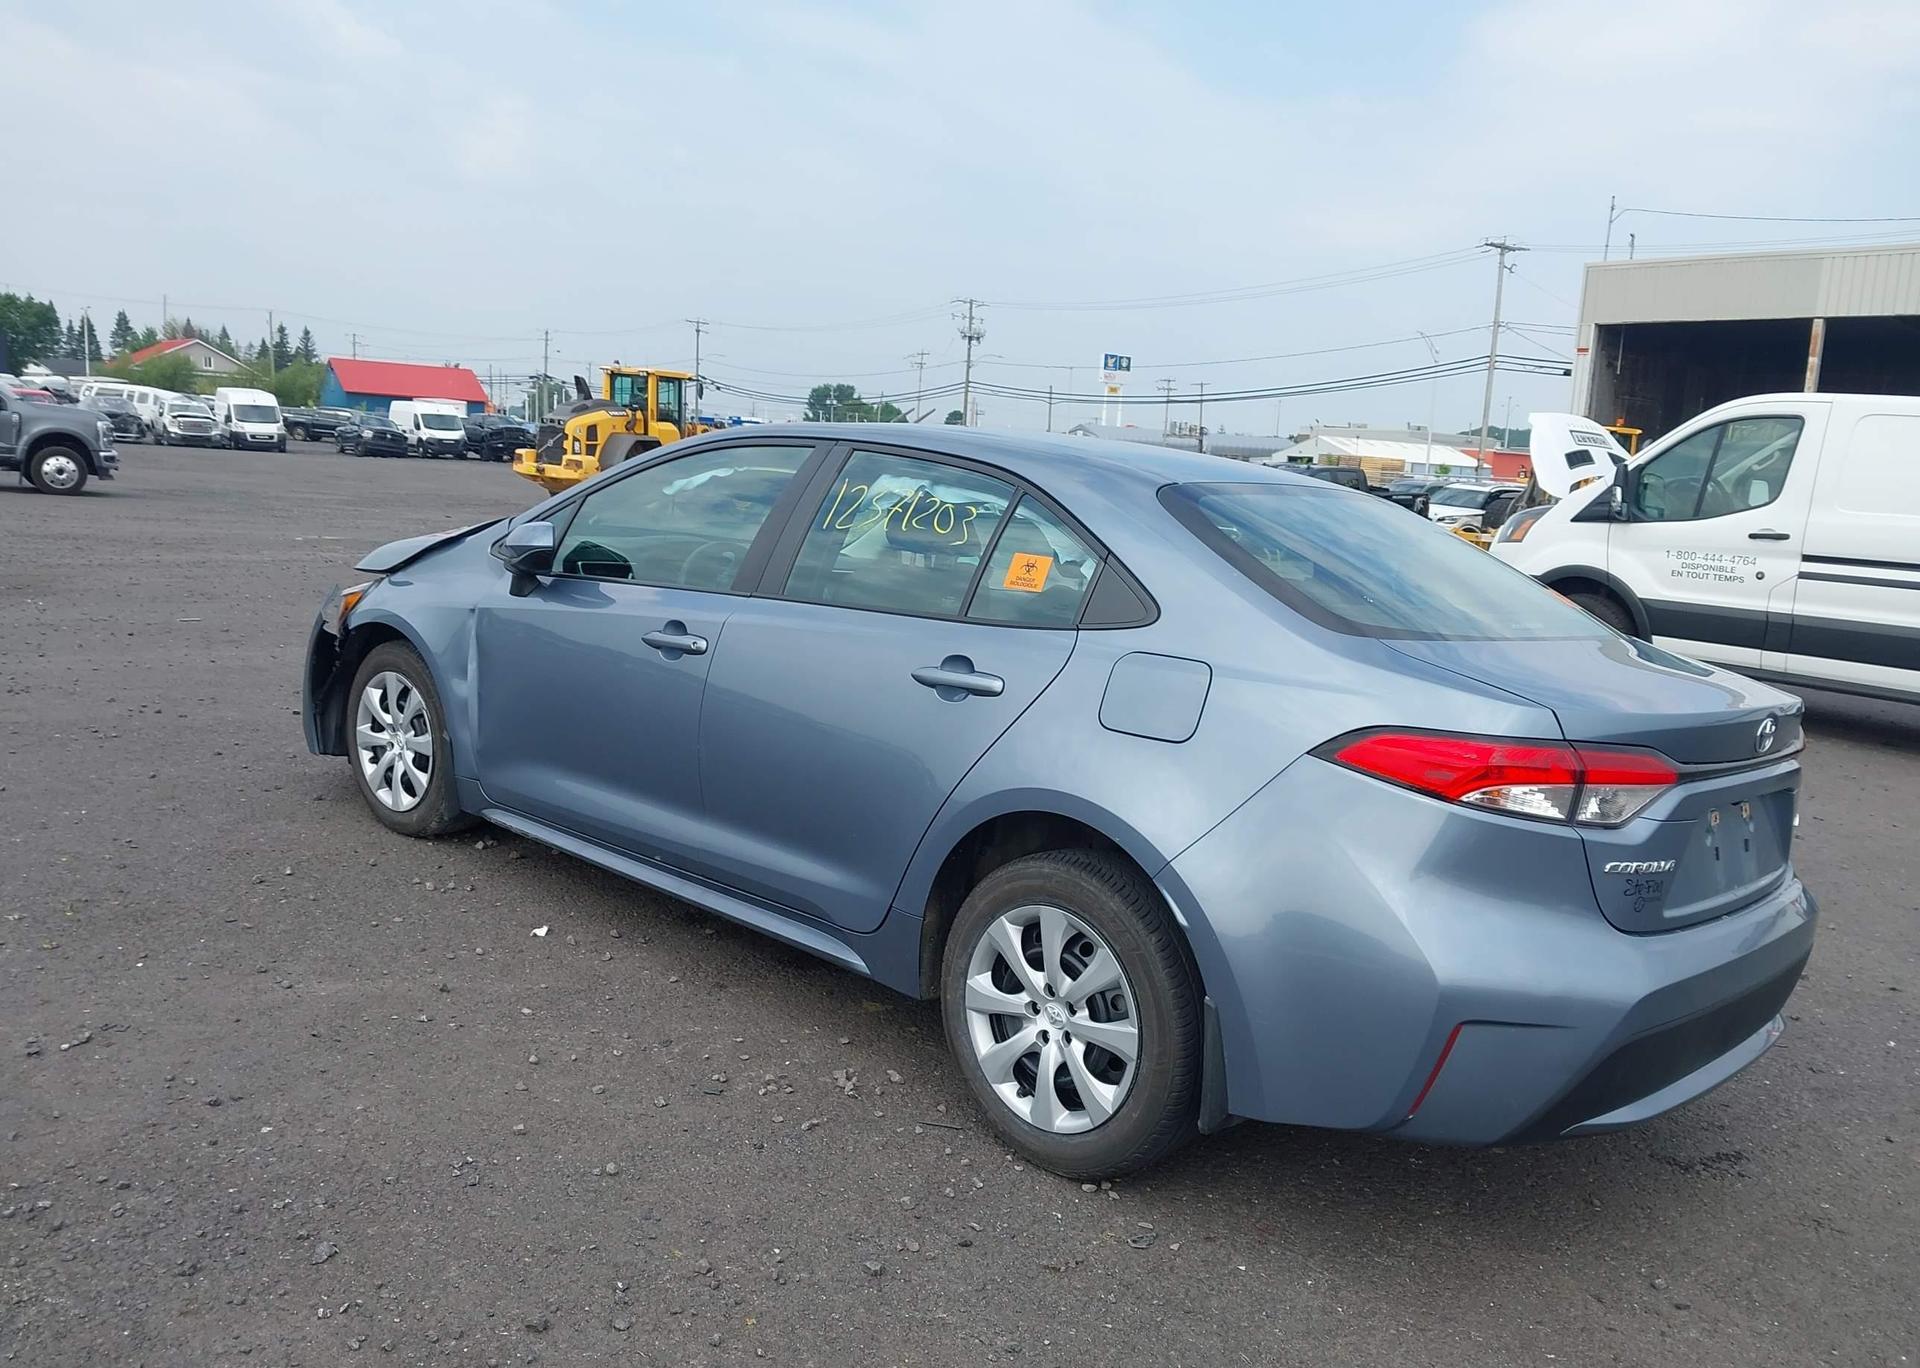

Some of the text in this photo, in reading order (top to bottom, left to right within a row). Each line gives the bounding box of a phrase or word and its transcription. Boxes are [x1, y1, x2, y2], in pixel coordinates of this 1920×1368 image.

[1665, 550, 1757, 566] 1-800-444-4764
[1681, 562, 1737, 574] DISPONIBLE
[1671, 569, 1745, 584] EN TOUT TEMPS
